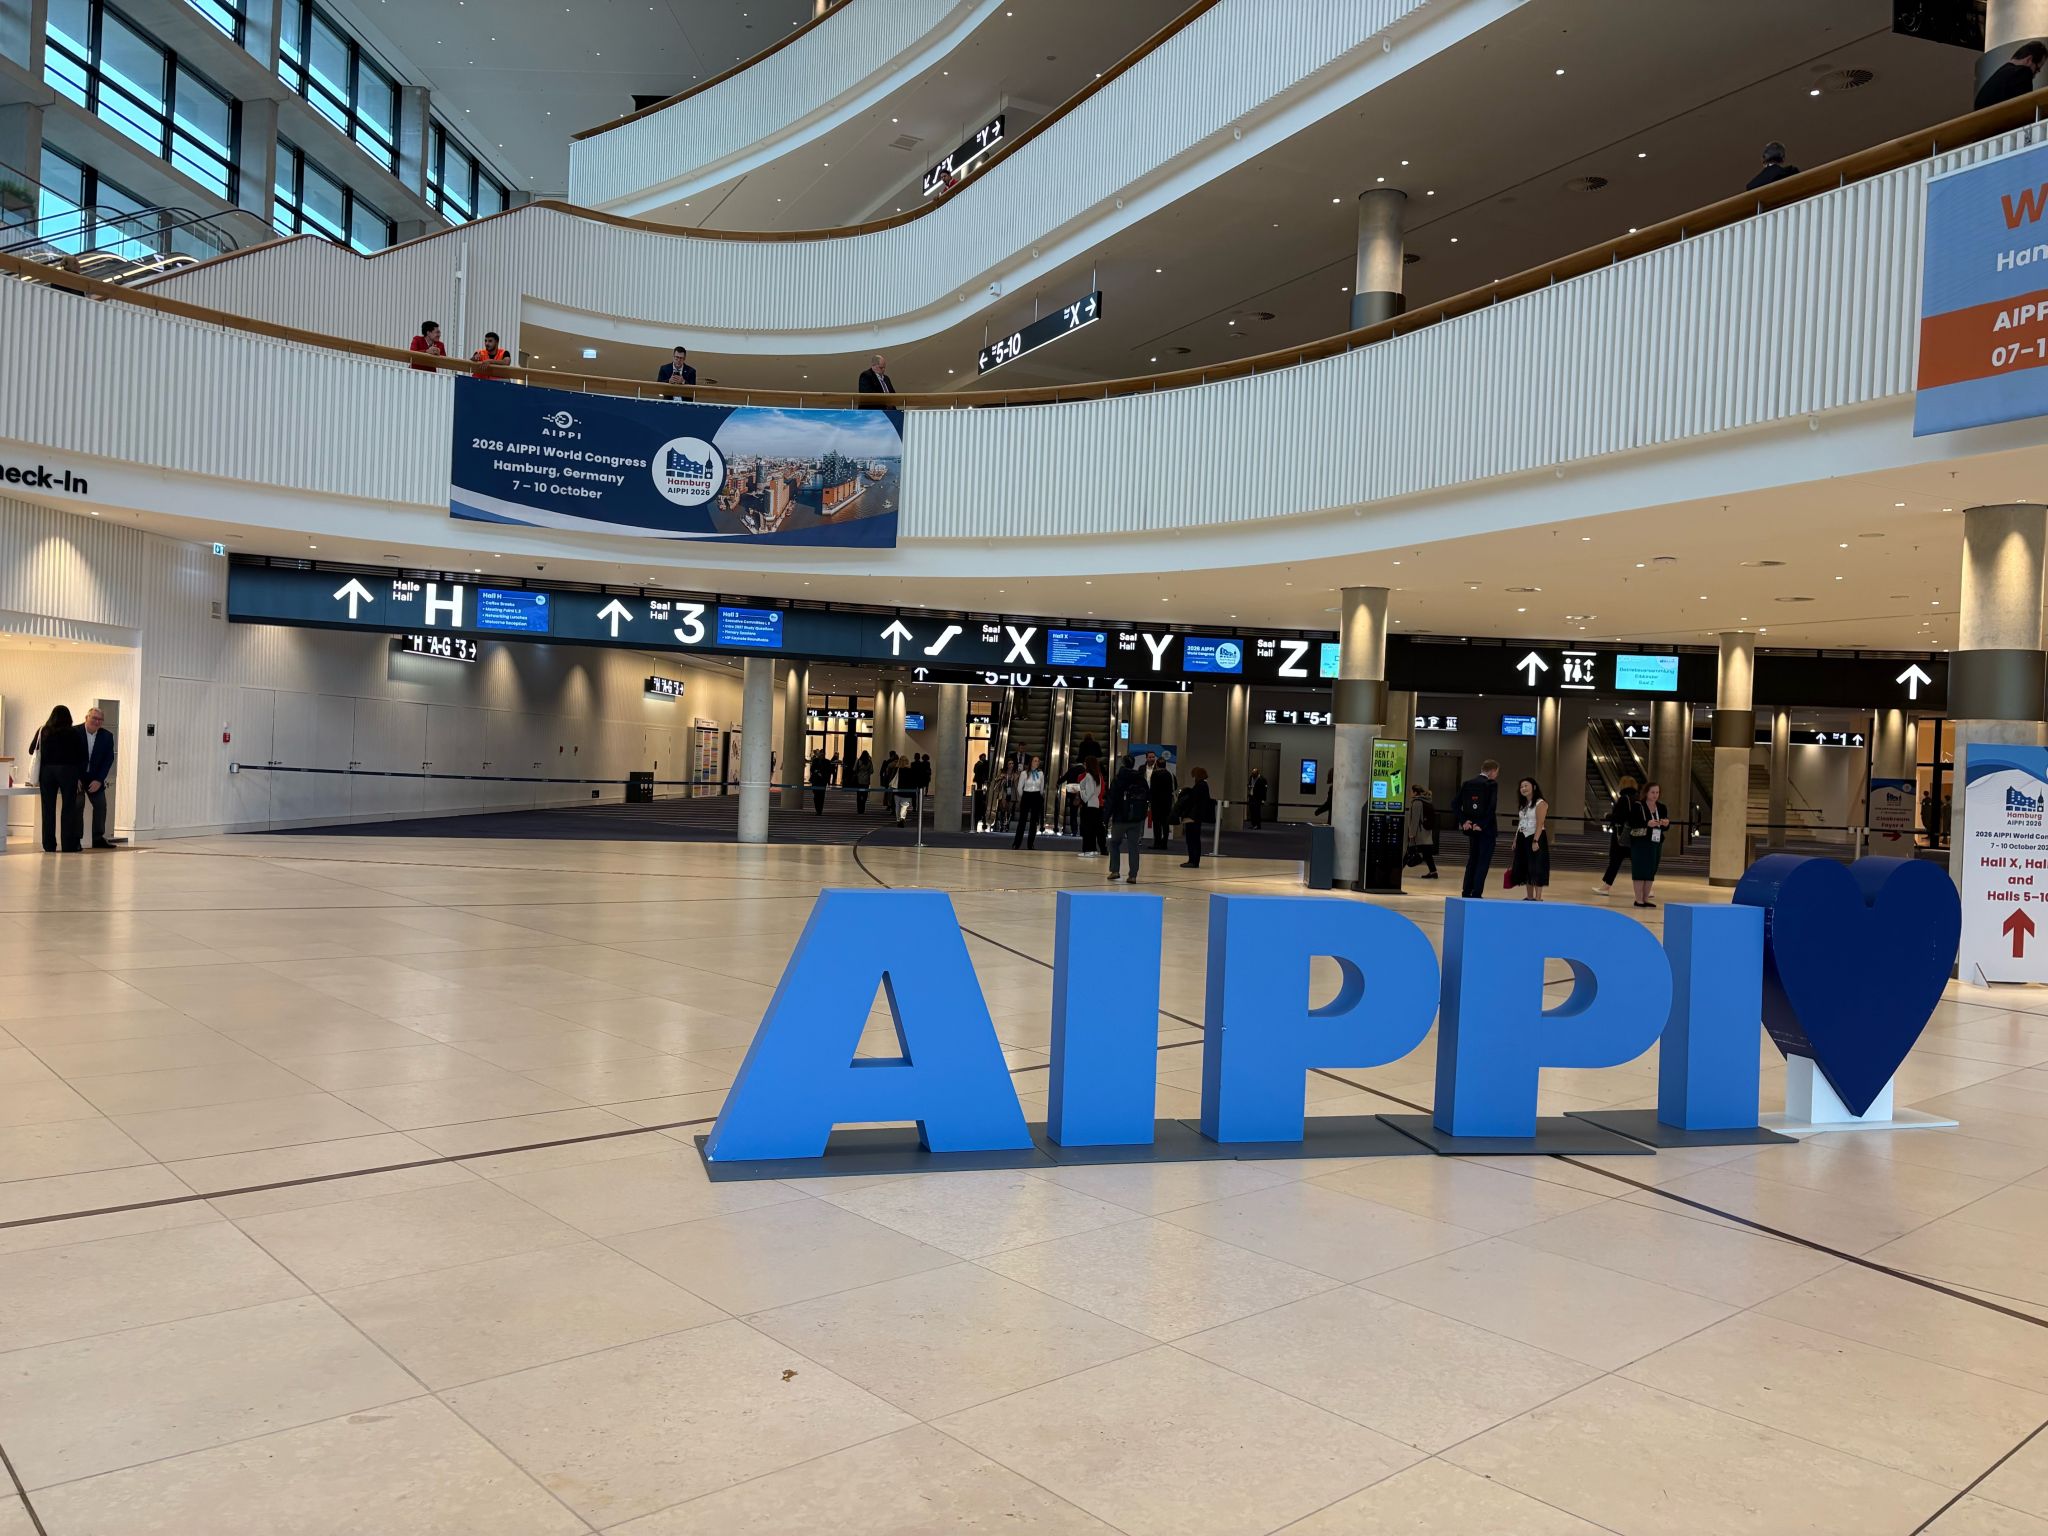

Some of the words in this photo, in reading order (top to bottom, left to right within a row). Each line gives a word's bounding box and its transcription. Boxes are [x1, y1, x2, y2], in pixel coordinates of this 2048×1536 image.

[981, 126, 989, 148] Y
[1069, 301, 1081, 328] X
[996, 332, 1021, 363] 5-10
[542, 428, 582, 439] AIPPI
[472, 438, 504, 451] 2026
[506, 443, 540, 456] AIPPI
[543, 446, 582, 461] World
[585, 452, 647, 468] Congress
[493, 460, 560, 478] Hamburg,
[563, 467, 625, 487] Germany
[667, 478, 711, 489] Hamburg
[512, 480, 520, 490] 7
[534, 482, 547, 493] 10
[550, 484, 603, 499] October
[393, 580, 421, 592] Halle
[393, 591, 413, 602] Hall
[425, 583, 463, 627] H
[650, 601, 671, 611] Saal
[650, 611, 668, 621] Hall
[674, 602, 705, 644] 3
[982, 624, 1001, 634] Saal
[982, 634, 999, 643] Hall
[1120, 632, 1137, 641] Saal
[414, 635, 422, 651] H
[430, 636, 451, 656] A-G
[459, 640, 466, 658] 3
[1004, 625, 1037, 665] X
[1120, 642, 1135, 650] Hall
[1257, 639, 1275, 648] Saal
[1142, 634, 1174, 671] Y
[1257, 649, 1273, 657] Hall
[1278, 640, 1309, 678] Z
[1374, 760, 1394, 768] POWER
[2007, 812, 2042, 820] Hamburg
[1981, 857, 2006, 867] Hall
[2010, 858, 2021, 869] X,
[2025, 859, 2048, 869] Hal
[2008, 875, 2033, 885] and
[1987, 891, 2020, 901] Halls
[703, 888, 1764, 1162] AIPPI
